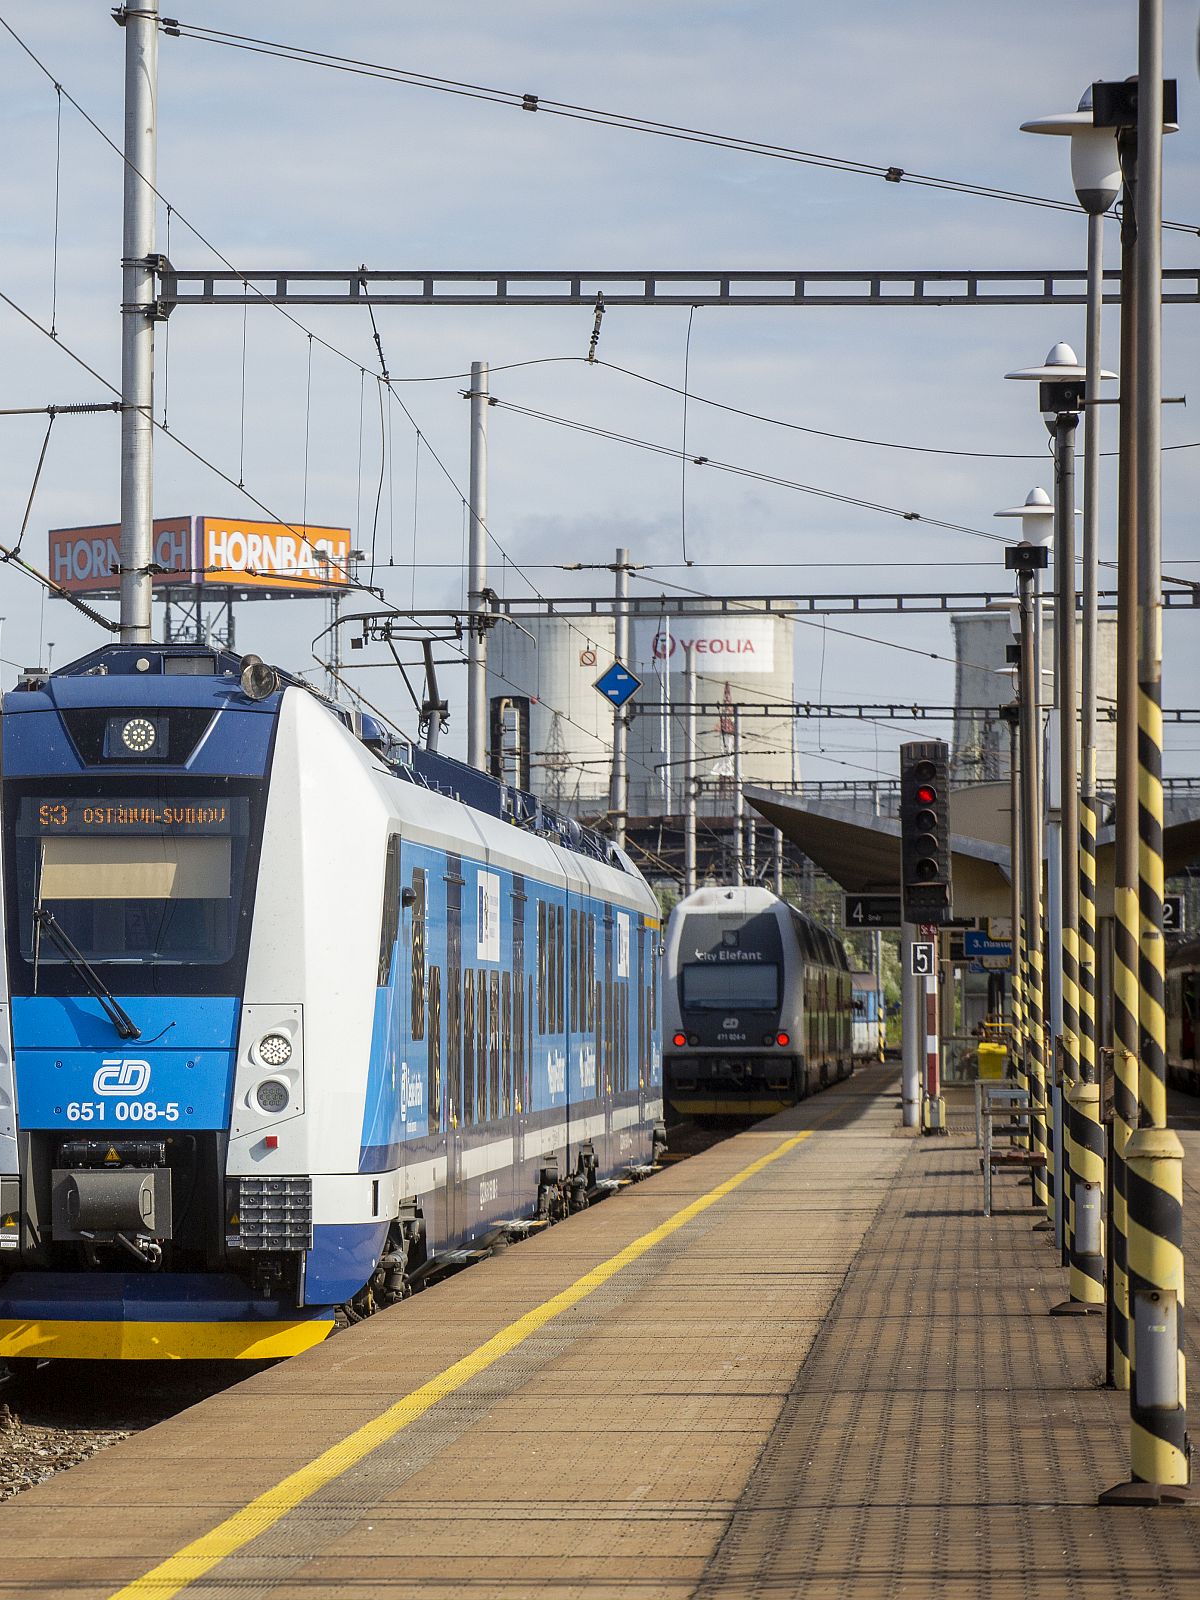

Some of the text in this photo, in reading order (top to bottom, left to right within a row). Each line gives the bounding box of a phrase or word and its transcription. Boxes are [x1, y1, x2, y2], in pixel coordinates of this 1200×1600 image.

[54, 530, 187, 581] HORNCH
[39, 805, 68, 825] S3
[852, 901, 864, 923] 4
[1162, 903, 1174, 925] 2
[719, 950, 762, 960] Elefant
[916, 945, 928, 973] 5
[66, 1102, 179, 1121] 651 008-5
